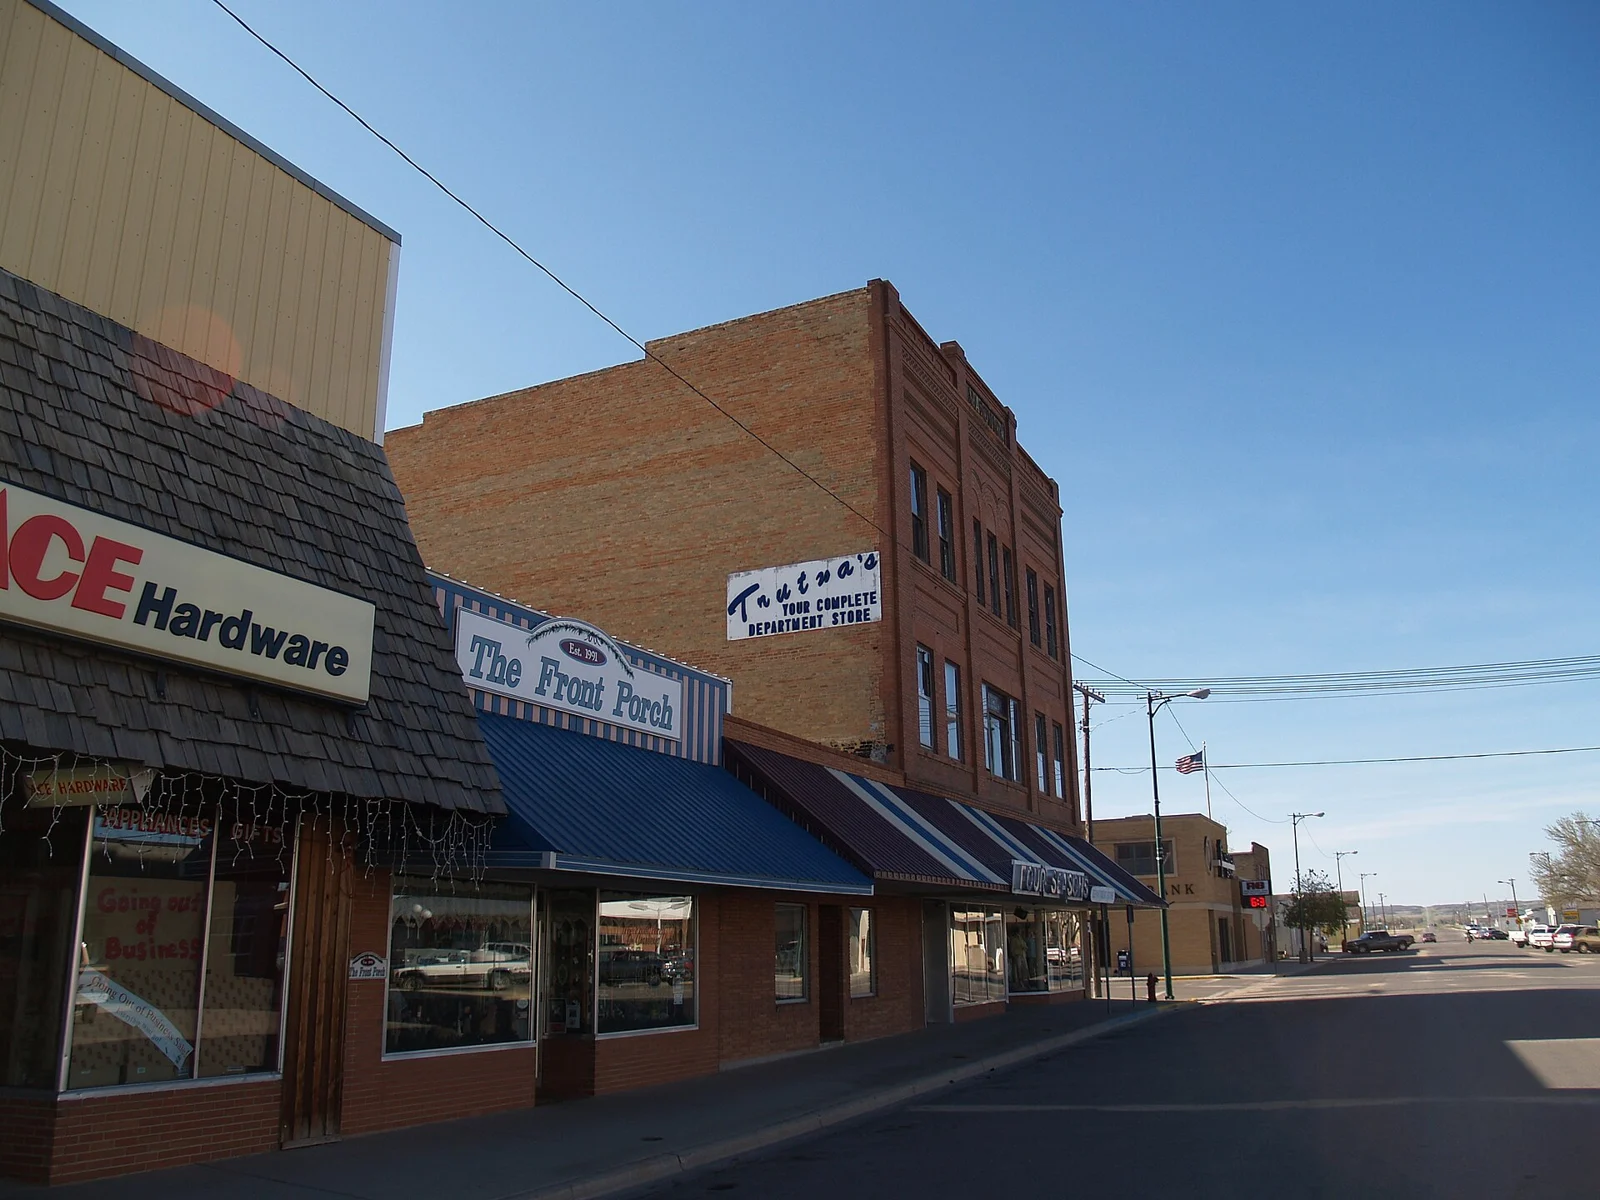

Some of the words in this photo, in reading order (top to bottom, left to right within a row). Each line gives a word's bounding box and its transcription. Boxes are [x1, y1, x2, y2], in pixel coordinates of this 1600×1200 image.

[0, 487, 144, 620] CE
[133, 580, 350, 677] Hardware
[782, 600, 810, 617] YOUR
[816, 590, 878, 612] COMPLETE
[748, 613, 825, 637] DEPARTMENT
[831, 608, 871, 626] STORE
[568, 642, 583, 658] Est.
[584, 648, 599, 663] 1991
[469, 634, 523, 689] The
[534, 656, 606, 712] Front
[612, 680, 674, 731] Porch
[57, 777, 130, 795] HARDWARE
[104, 808, 210, 837] APPLIANCES
[231, 821, 283, 844] GIFTS
[1020, 865, 1047, 893] FOUR
[97, 886, 162, 914] Going
[167, 892, 201, 913] out
[135, 911, 158, 935] of
[104, 936, 200, 961] Business
[89, 975, 118, 1000] Going
[118, 992, 136, 1009] Out
[135, 1004, 145, 1016] of
